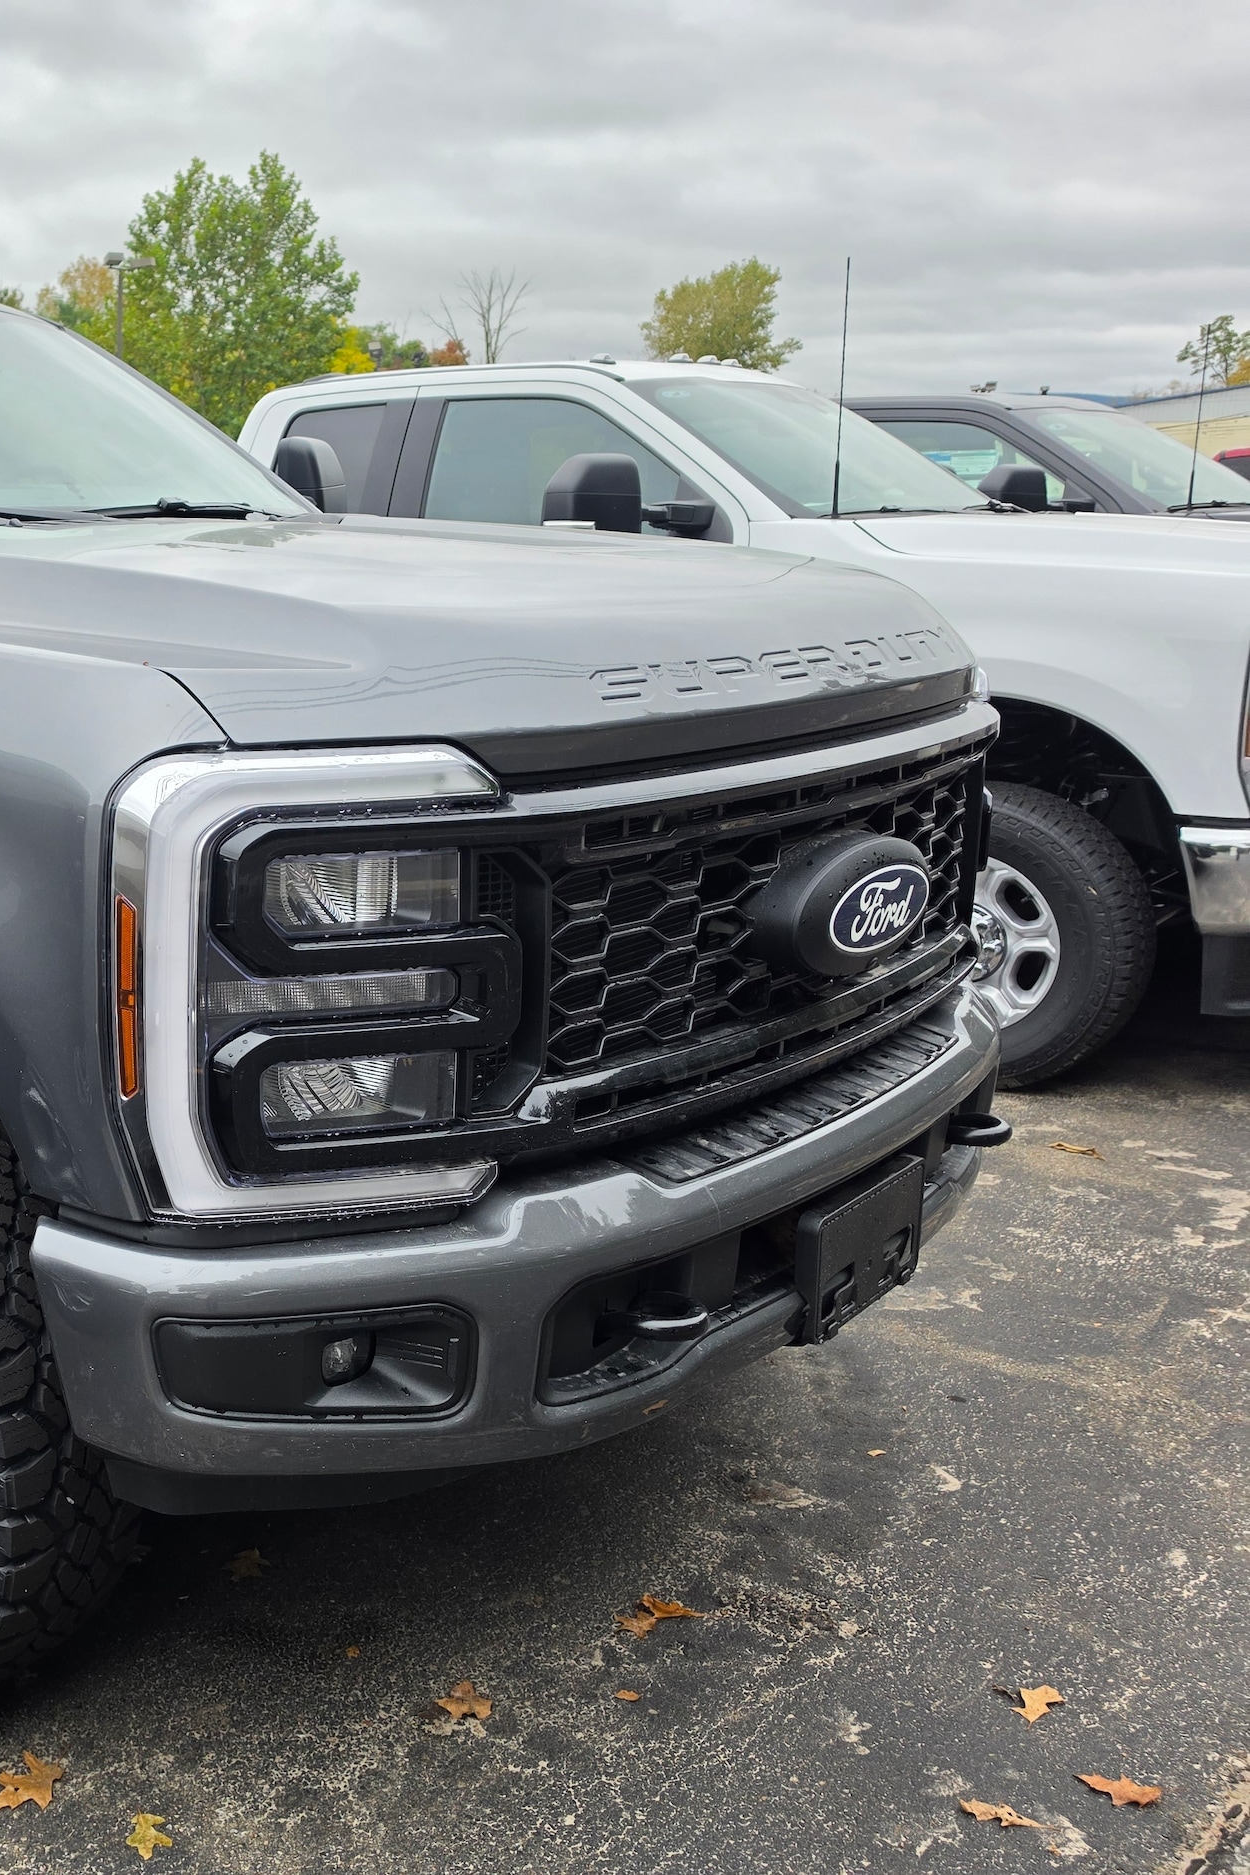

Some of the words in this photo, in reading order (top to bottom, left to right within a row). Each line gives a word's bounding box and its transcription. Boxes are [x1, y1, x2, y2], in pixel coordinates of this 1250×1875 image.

[588, 645, 854, 706] SUPER
[844, 627, 956, 668] DUTY
[851, 877, 914, 942] Ford
